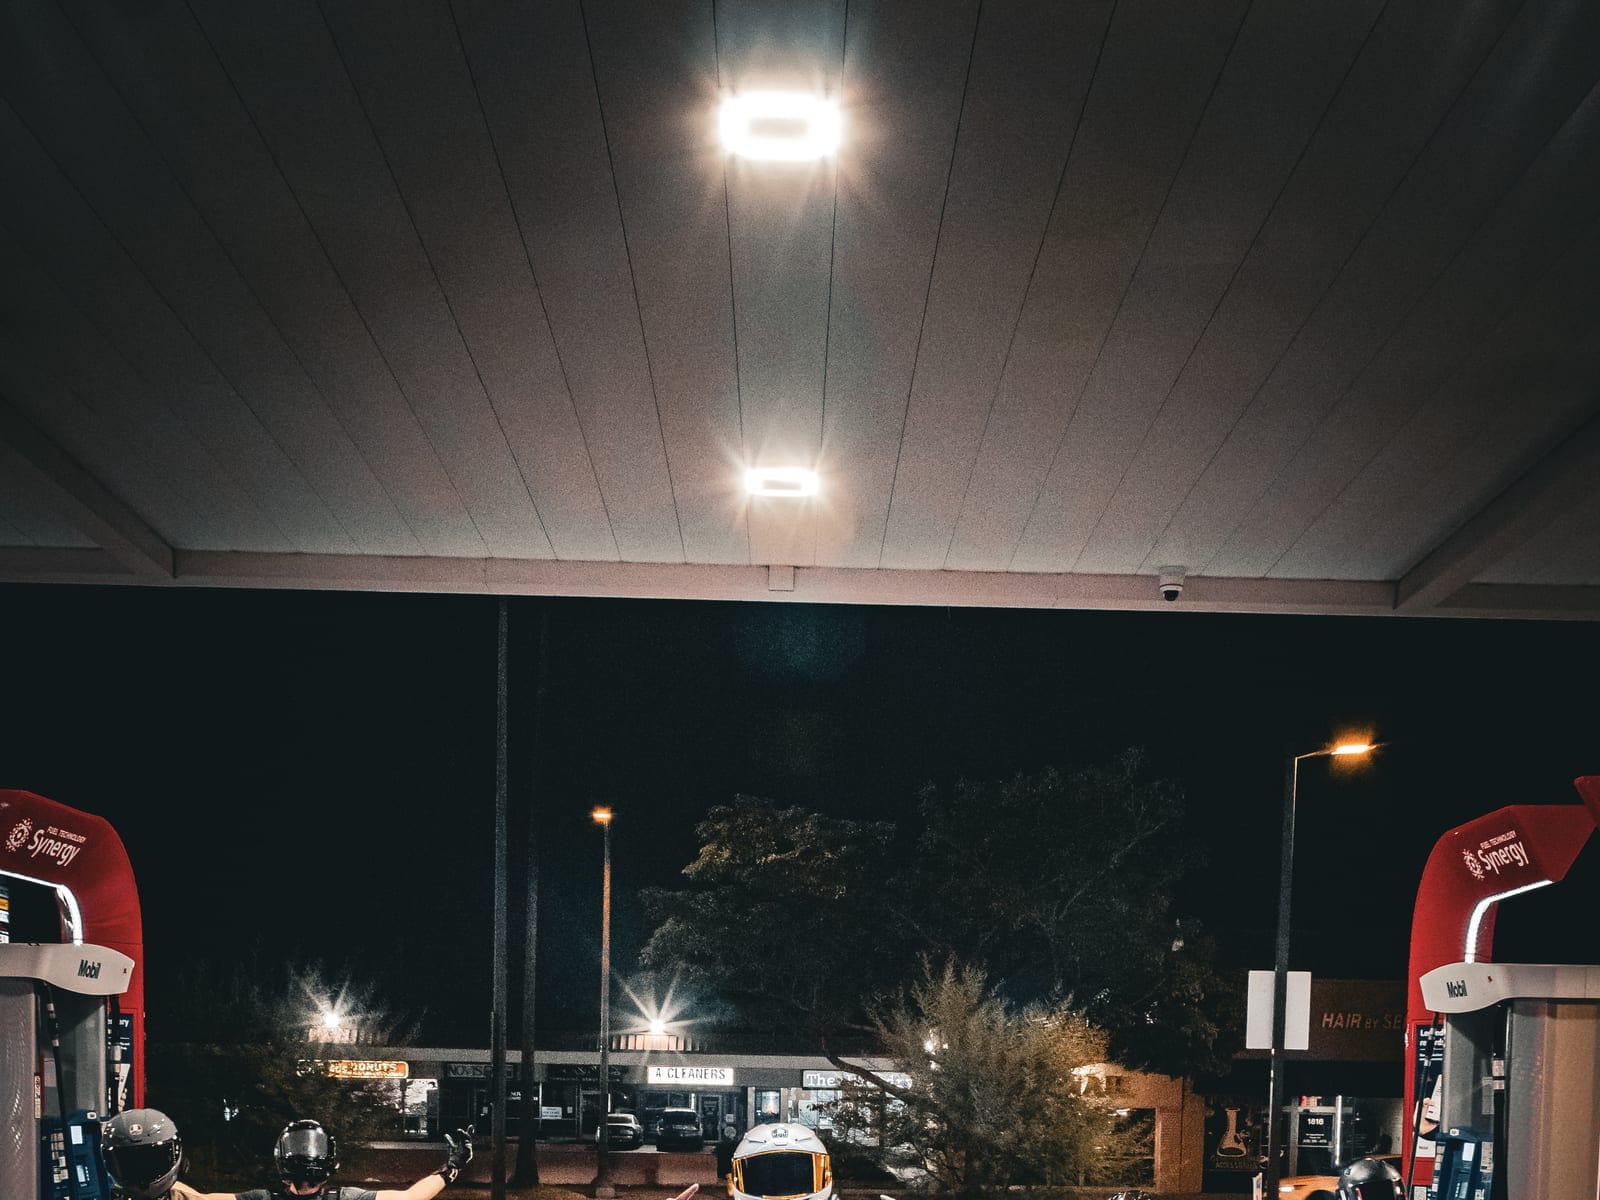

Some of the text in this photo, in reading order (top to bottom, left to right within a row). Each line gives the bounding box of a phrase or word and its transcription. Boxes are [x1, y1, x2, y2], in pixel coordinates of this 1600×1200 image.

[27, 829, 80, 867] Synergy
[1477, 841, 1529, 874] Synergy
[77, 959, 101, 979] Mobil
[1446, 979, 1468, 998] Mobil
[1321, 1013, 1362, 1028] HAIR
[667, 1067, 726, 1080] CLEANERS
[806, 1073, 837, 1087] The
